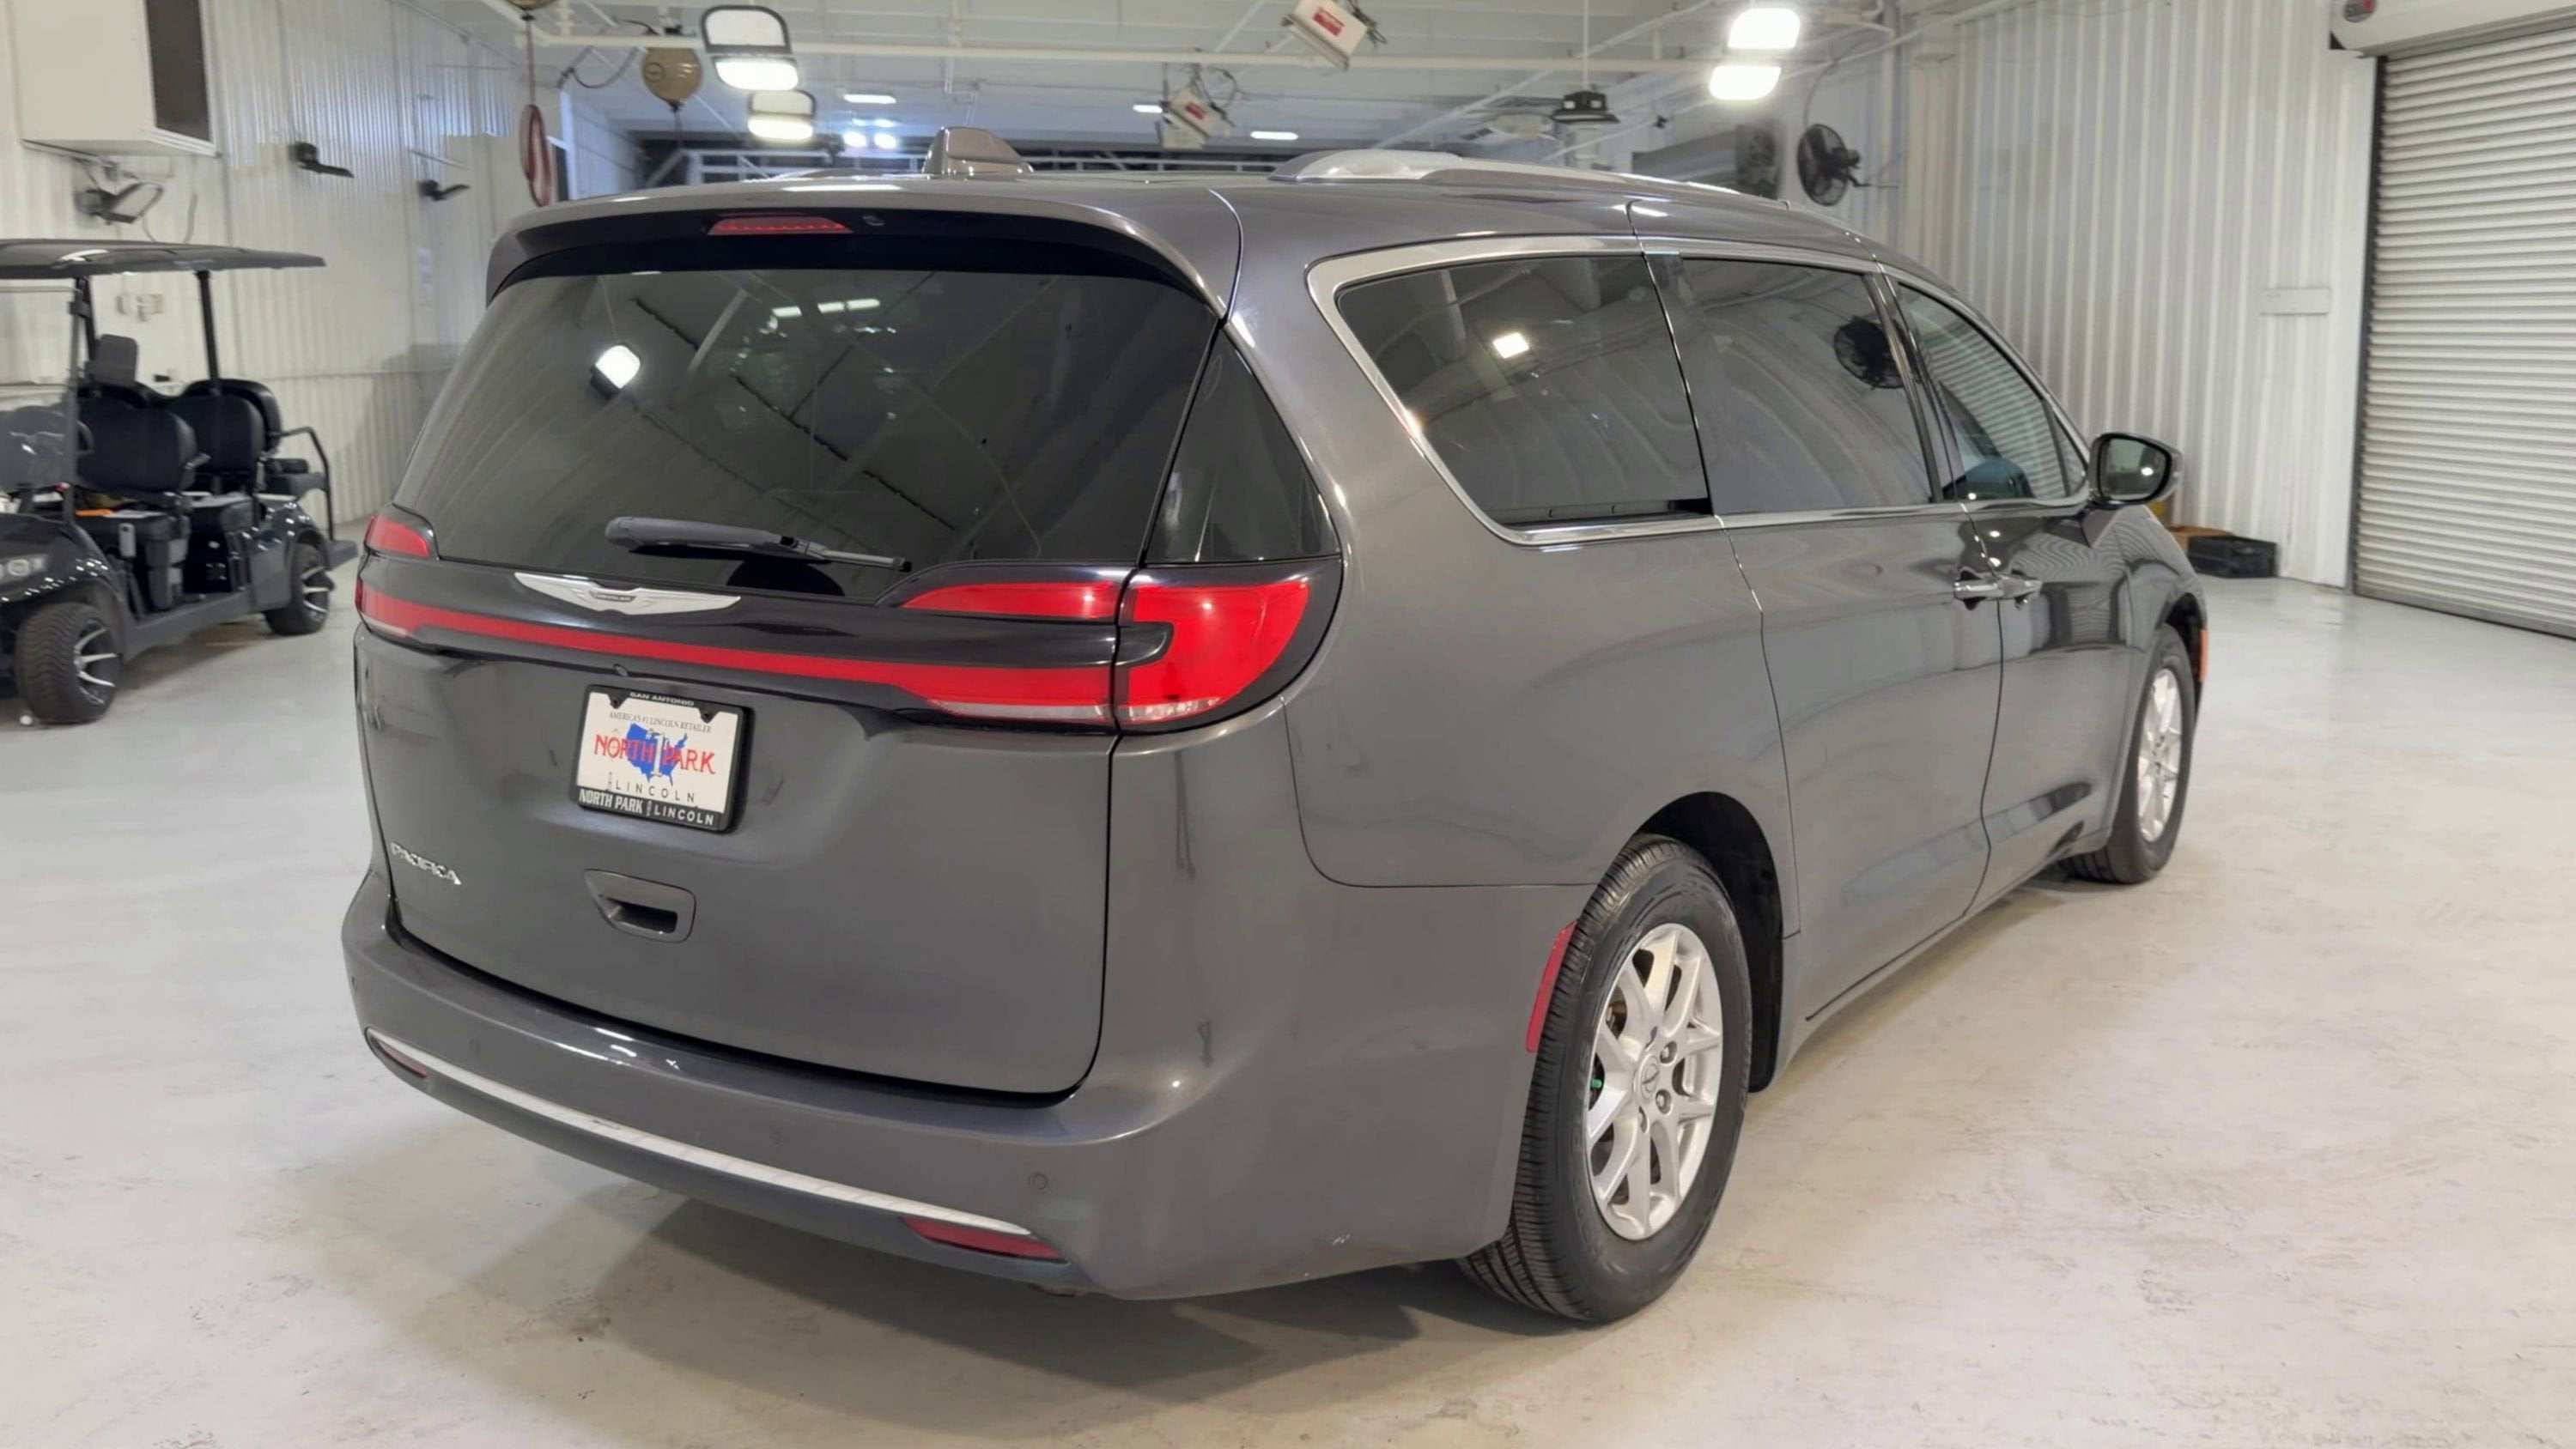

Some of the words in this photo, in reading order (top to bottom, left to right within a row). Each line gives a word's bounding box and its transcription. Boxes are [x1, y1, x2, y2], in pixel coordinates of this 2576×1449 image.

[652, 694, 695, 706] ANTONIO
[650, 718, 679, 729] LINCOLN
[679, 721, 711, 733] RETAILER
[593, 734, 655, 763] NORTH
[660, 743, 716, 774] PARK
[616, 779, 695, 803] LINCOLN
[579, 788, 613, 808] NORTH
[614, 796, 643, 815] PARK
[653, 804, 714, 826] LINCOLN
